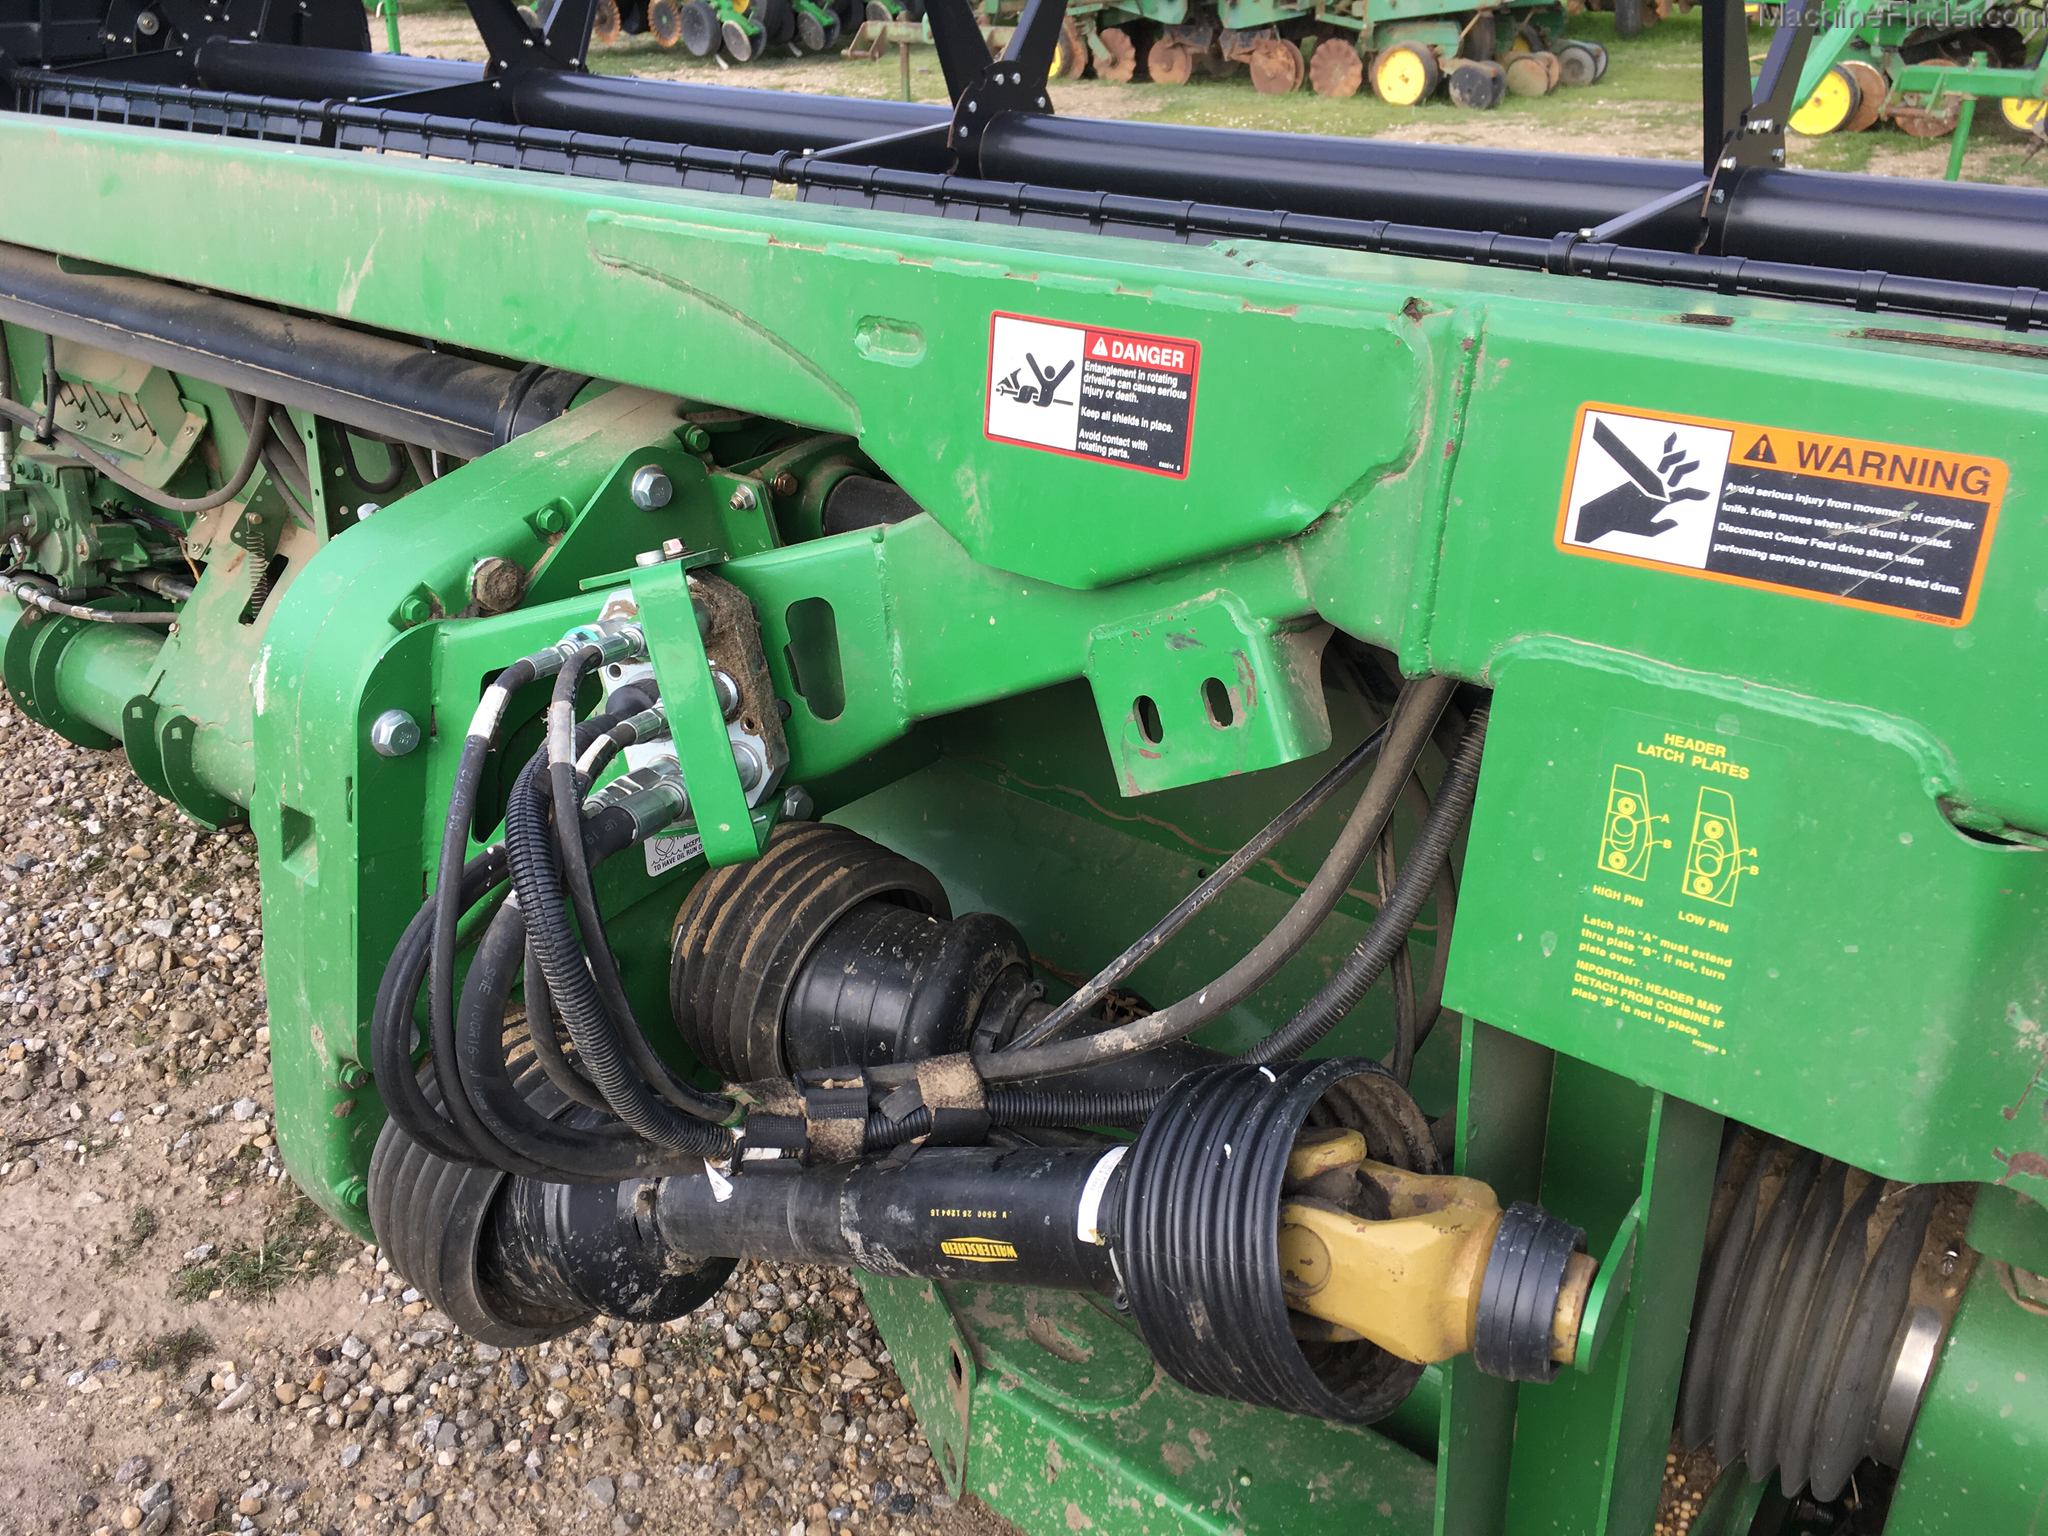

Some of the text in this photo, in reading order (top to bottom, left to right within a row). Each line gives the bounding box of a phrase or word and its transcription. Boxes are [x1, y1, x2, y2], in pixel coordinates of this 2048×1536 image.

[1112, 341, 1184, 368] DANGER
[1083, 373, 1187, 399] driveline can cause serious
[1084, 361, 1178, 388] Entanglement in rotating
[1083, 384, 1138, 403] injury or death.
[1081, 406, 1173, 433] Keep all shields in place.
[1078, 441, 1129, 459] rotating parts.
[1079, 428, 1148, 451] Avoid contact with
[1797, 441, 1991, 496] WARNING
[1726, 482, 1755, 494] Avoid
[1756, 489, 1794, 501] serious
[1795, 493, 1826, 507] injury
[1827, 498, 1851, 510] from
[1910, 513, 1923, 521] of
[1924, 516, 1976, 530] cutterbar.
[1722, 502, 1952, 549] knife. Knife moves when feed drum is rotated.
[1718, 522, 1924, 566] Disconnect Center Feed drive shaft when
[1713, 544, 1962, 595] performing service or maintenance on feed drum.
[1664, 733, 1726, 758] HEADER
[1637, 742, 1749, 779] LATCH PLATES
[1661, 814, 1670, 823] A
[662, 857, 676, 868] HAVE
[686, 847, 697, 856] RUN
[1662, 839, 1672, 849] B
[1748, 847, 1757, 857] A
[1749, 865, 1759, 875] B
[1593, 885, 1643, 907] HIGH PIN
[1678, 911, 1729, 933] LOW PIN
[1581, 928, 1604, 942] thru
[1606, 937, 1635, 951] plate
[1663, 953, 1673, 963] If
[1701, 966, 1725, 980] turn
[1583, 914, 1614, 930] Latch
[1617, 926, 1635, 937] pin
[1660, 939, 1689, 954] must
[1691, 949, 1732, 967] extend
[1579, 943, 1636, 966] plate over.
[478, 966, 498, 995] SAE
[1575, 960, 1722, 1014] IMPORTANT: HEADER MAY
[1572, 987, 1598, 1001] plate
[1621, 1002, 1631, 1013] is
[1633, 1008, 1652, 1020] not
[1654, 1014, 1665, 1024] in
[1667, 1020, 1701, 1037] place.
[1574, 973, 1725, 1029] DETACH FROM COMBINE IF
[940, 1242, 1018, 1258] WALTERSCHEID
